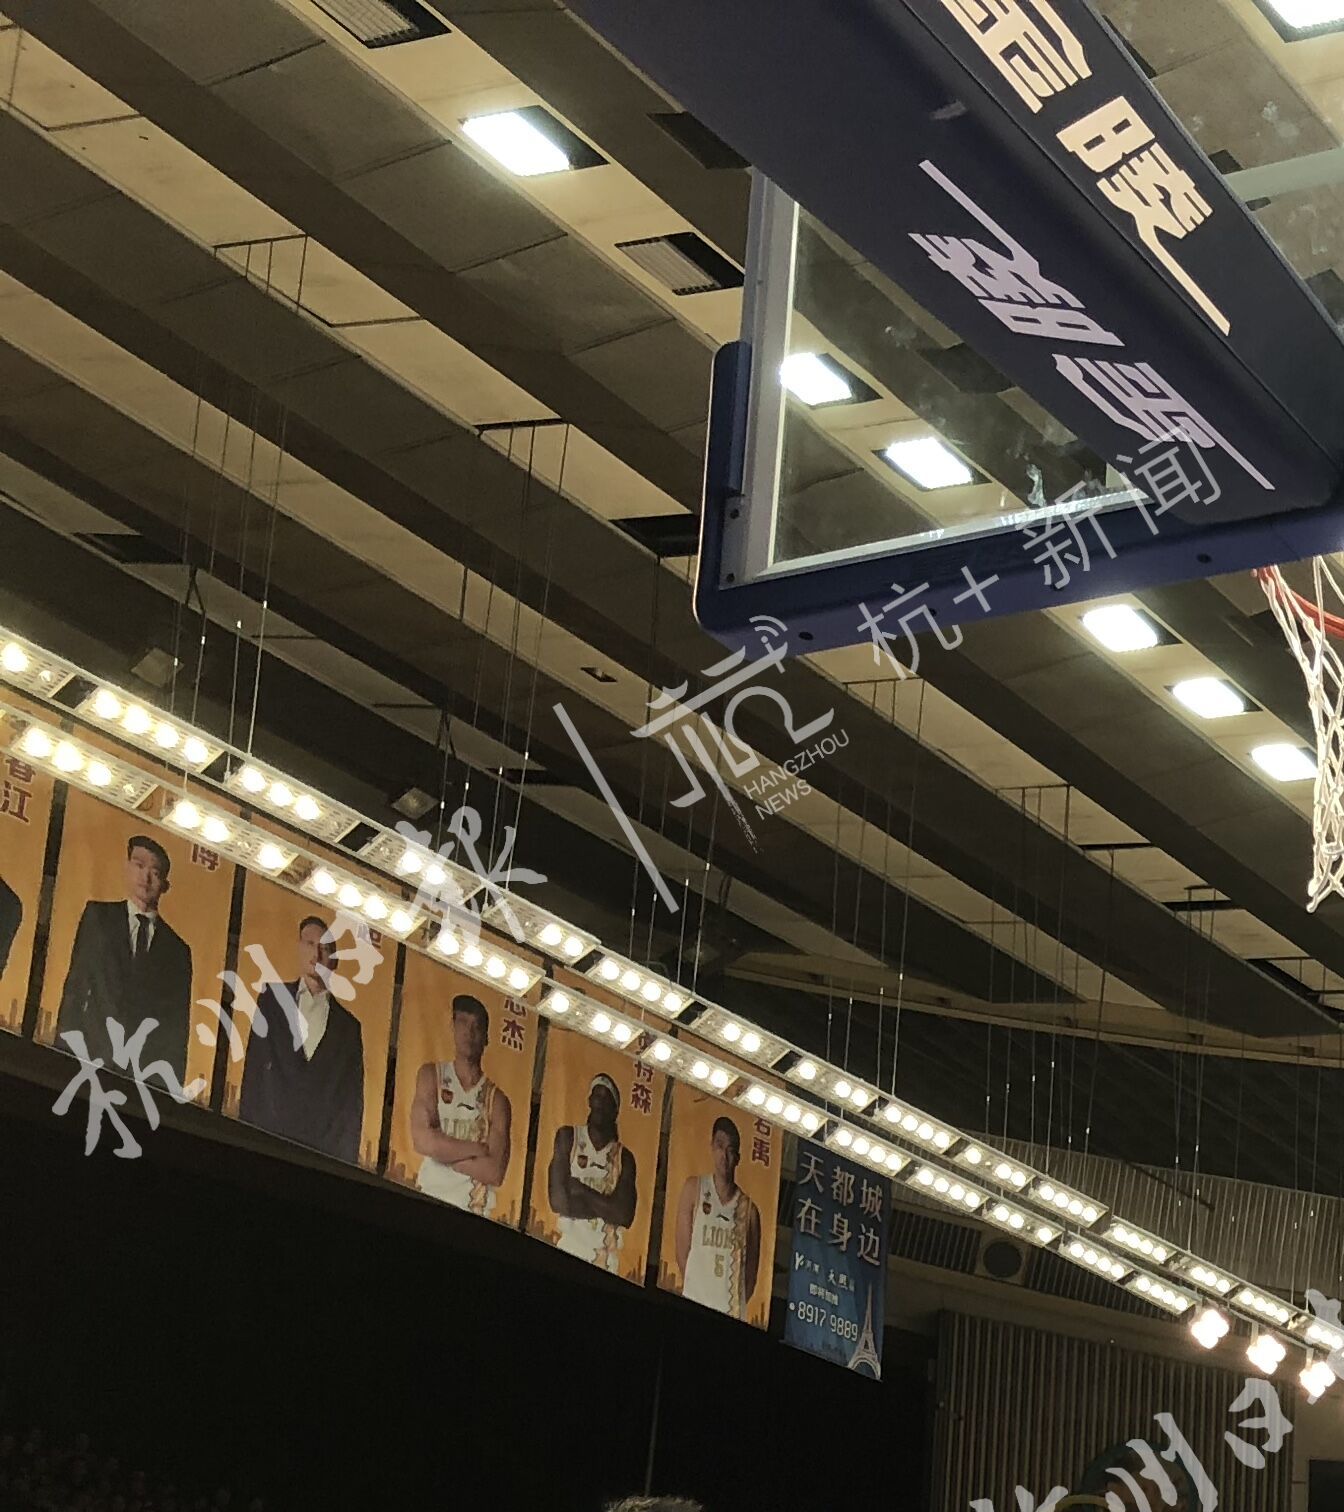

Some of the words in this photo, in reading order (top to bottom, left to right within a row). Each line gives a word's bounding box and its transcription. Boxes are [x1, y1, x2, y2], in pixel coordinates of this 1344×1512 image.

[799, 1151, 882, 1223] 天都城
[796, 1198, 881, 1266] 在身边
[797, 1301, 827, 1327] 8917
[830, 1314, 858, 1342] 9889
